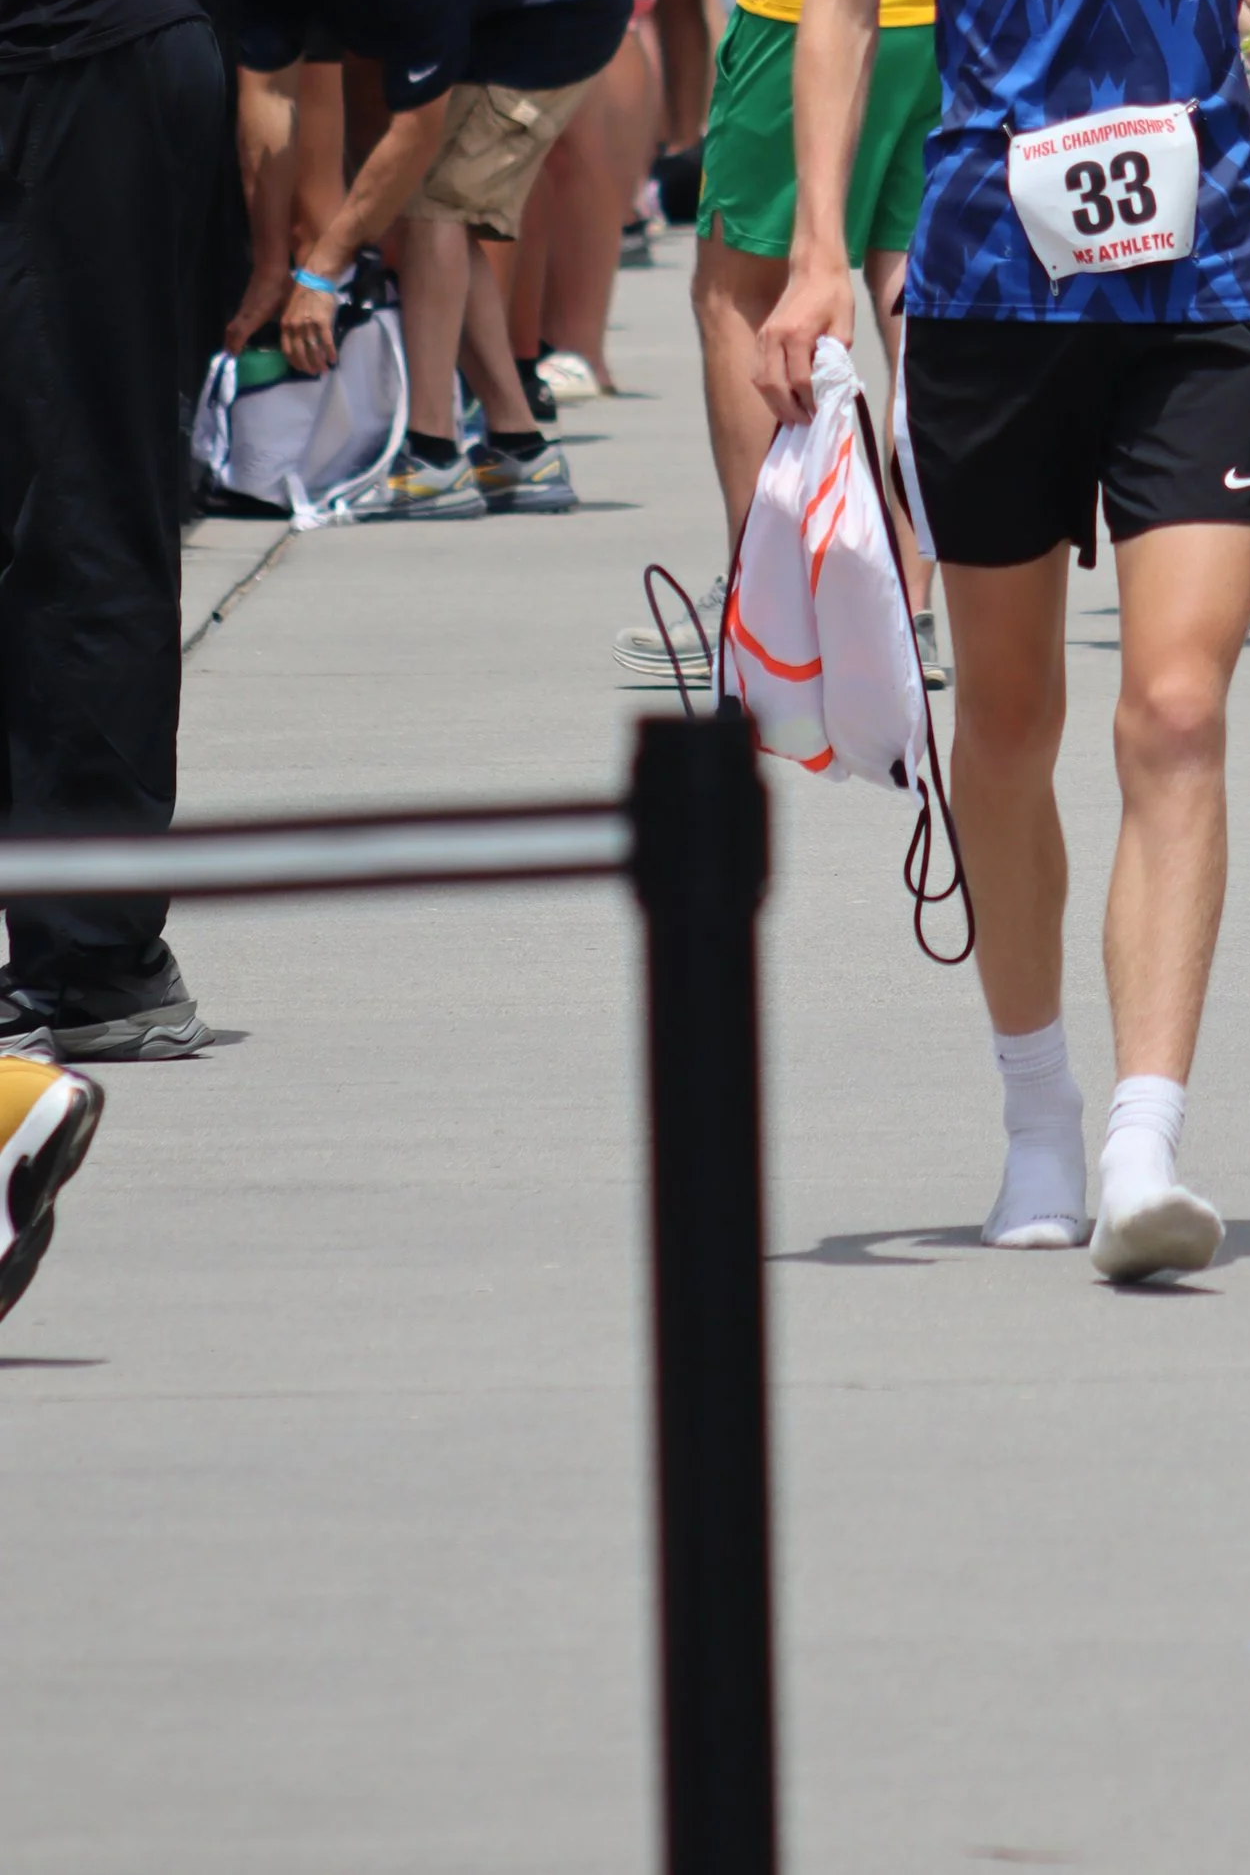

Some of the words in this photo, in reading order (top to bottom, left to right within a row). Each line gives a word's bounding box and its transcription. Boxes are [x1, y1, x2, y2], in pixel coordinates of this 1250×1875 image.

[1023, 140, 1058, 161] VHSL
[1061, 118, 1176, 152] CHAMPIONSHIPS
[1064, 150, 1158, 236] 33
[1098, 232, 1175, 263] ATHLETIC
